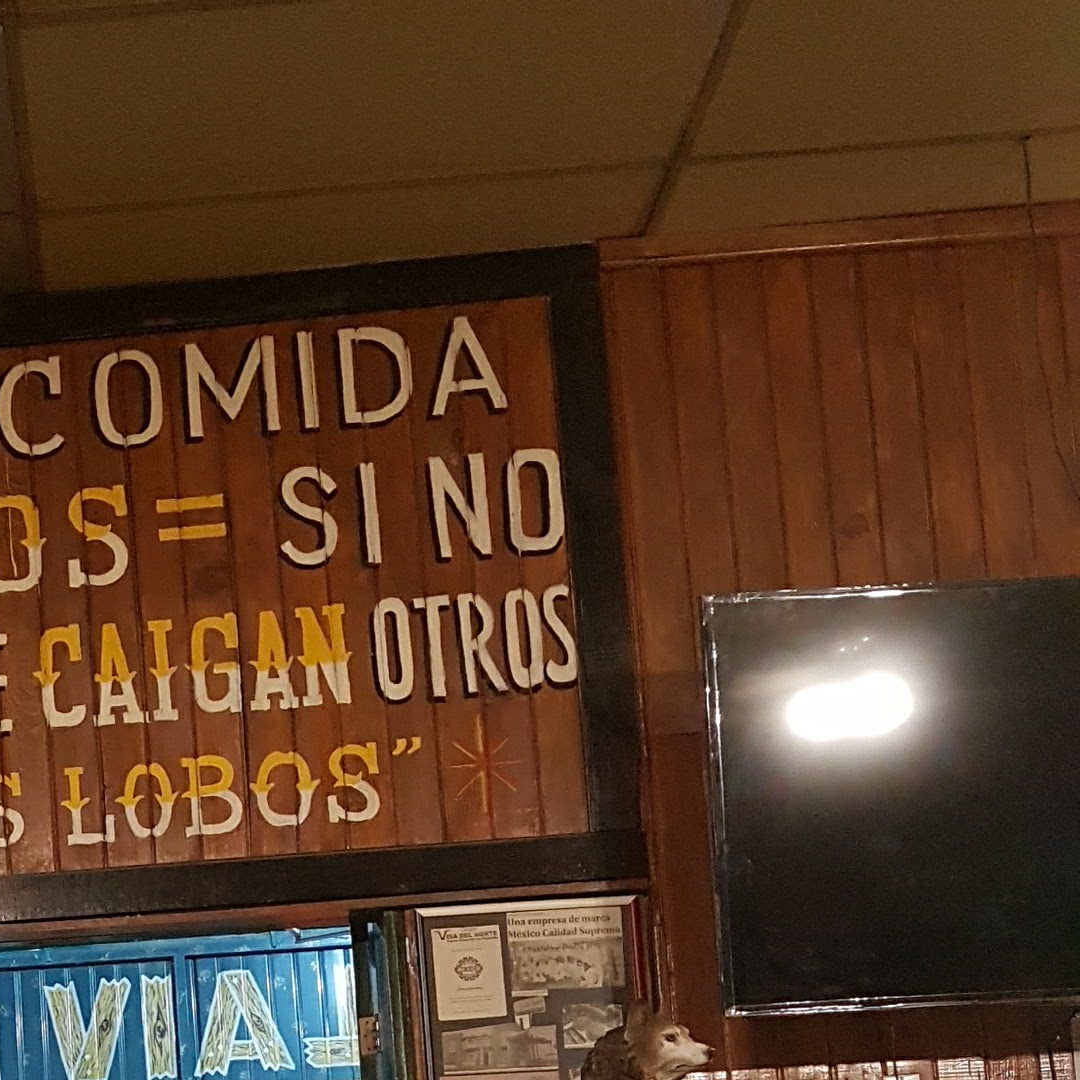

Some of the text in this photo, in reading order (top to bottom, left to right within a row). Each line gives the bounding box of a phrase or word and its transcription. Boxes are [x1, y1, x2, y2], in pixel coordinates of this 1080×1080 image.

[280, 462, 382, 567] SI
[428, 448, 567, 560] NO
[33, 602, 353, 729] CAIGAN
[373, 584, 580, 704] OTROS
[527, 916, 567, 928] empresa
[569, 914, 580, 924] de
[581, 914, 612, 924] marca
[542, 927, 578, 938] Calidad
